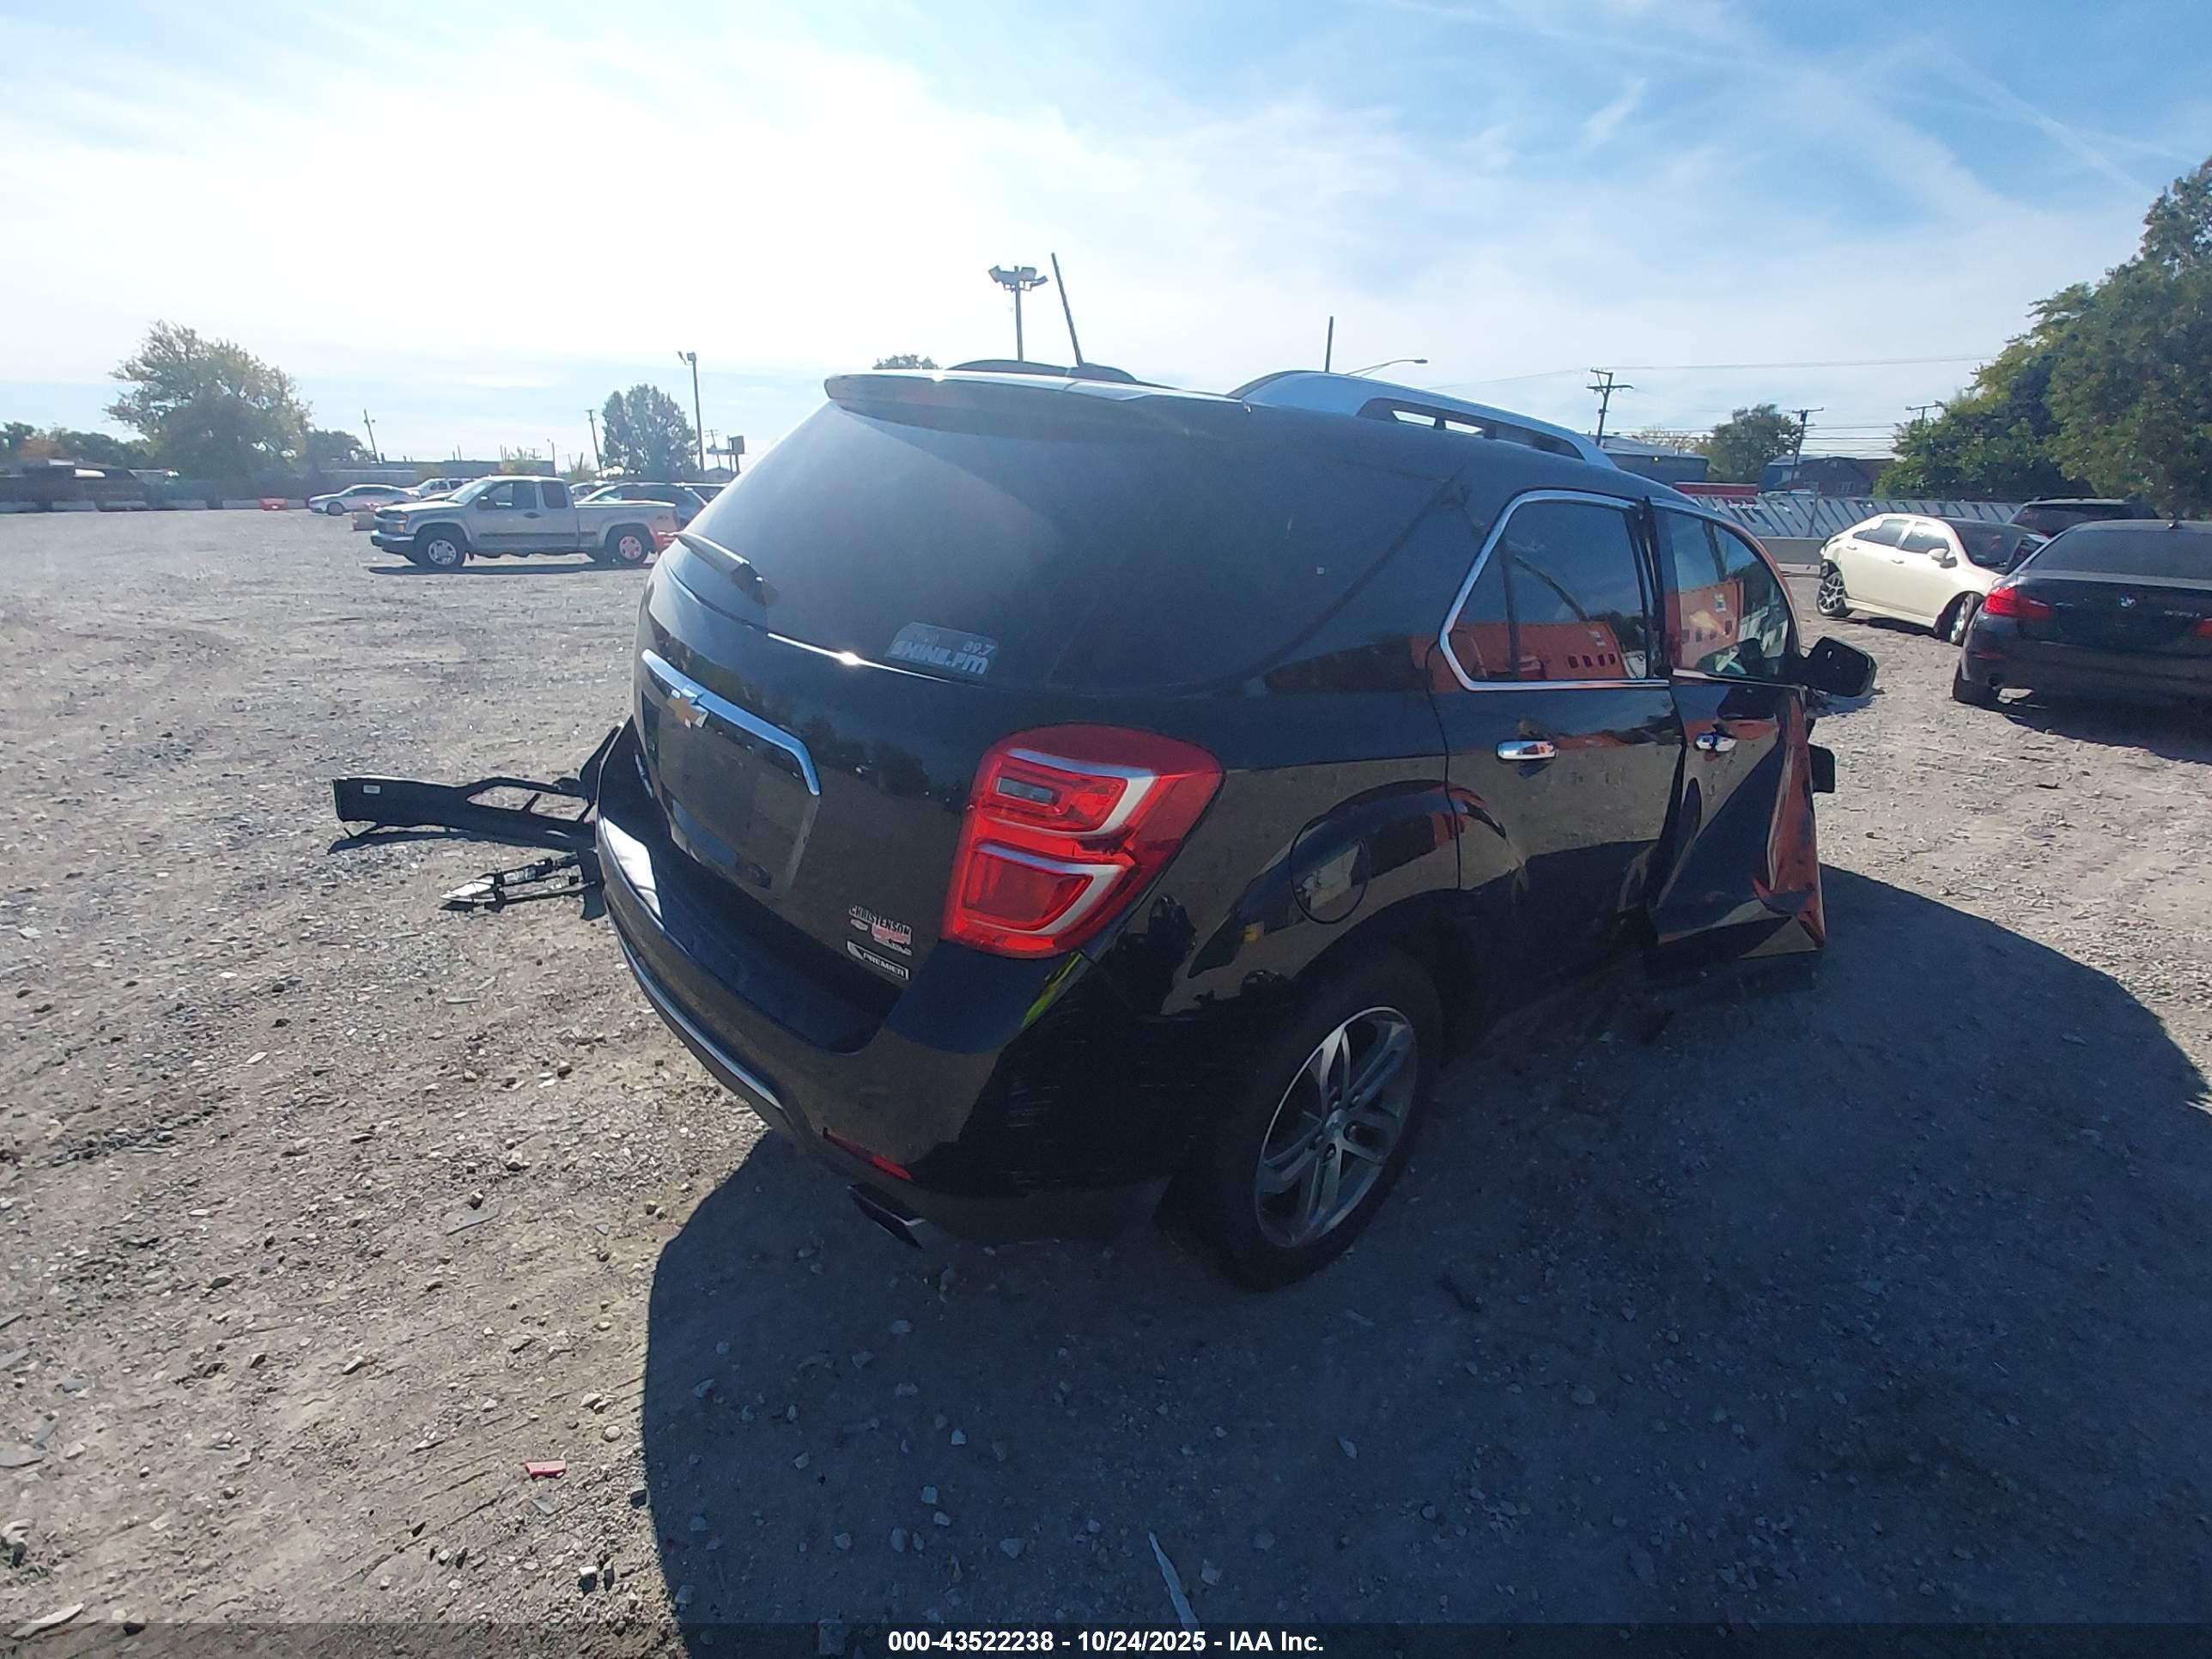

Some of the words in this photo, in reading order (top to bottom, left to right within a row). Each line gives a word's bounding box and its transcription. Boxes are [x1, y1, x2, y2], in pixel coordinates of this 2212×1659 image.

[963, 641, 996, 656] 89.7
[849, 905, 912, 935] CHRISTENSON
[863, 952, 905, 977] PREMIER
